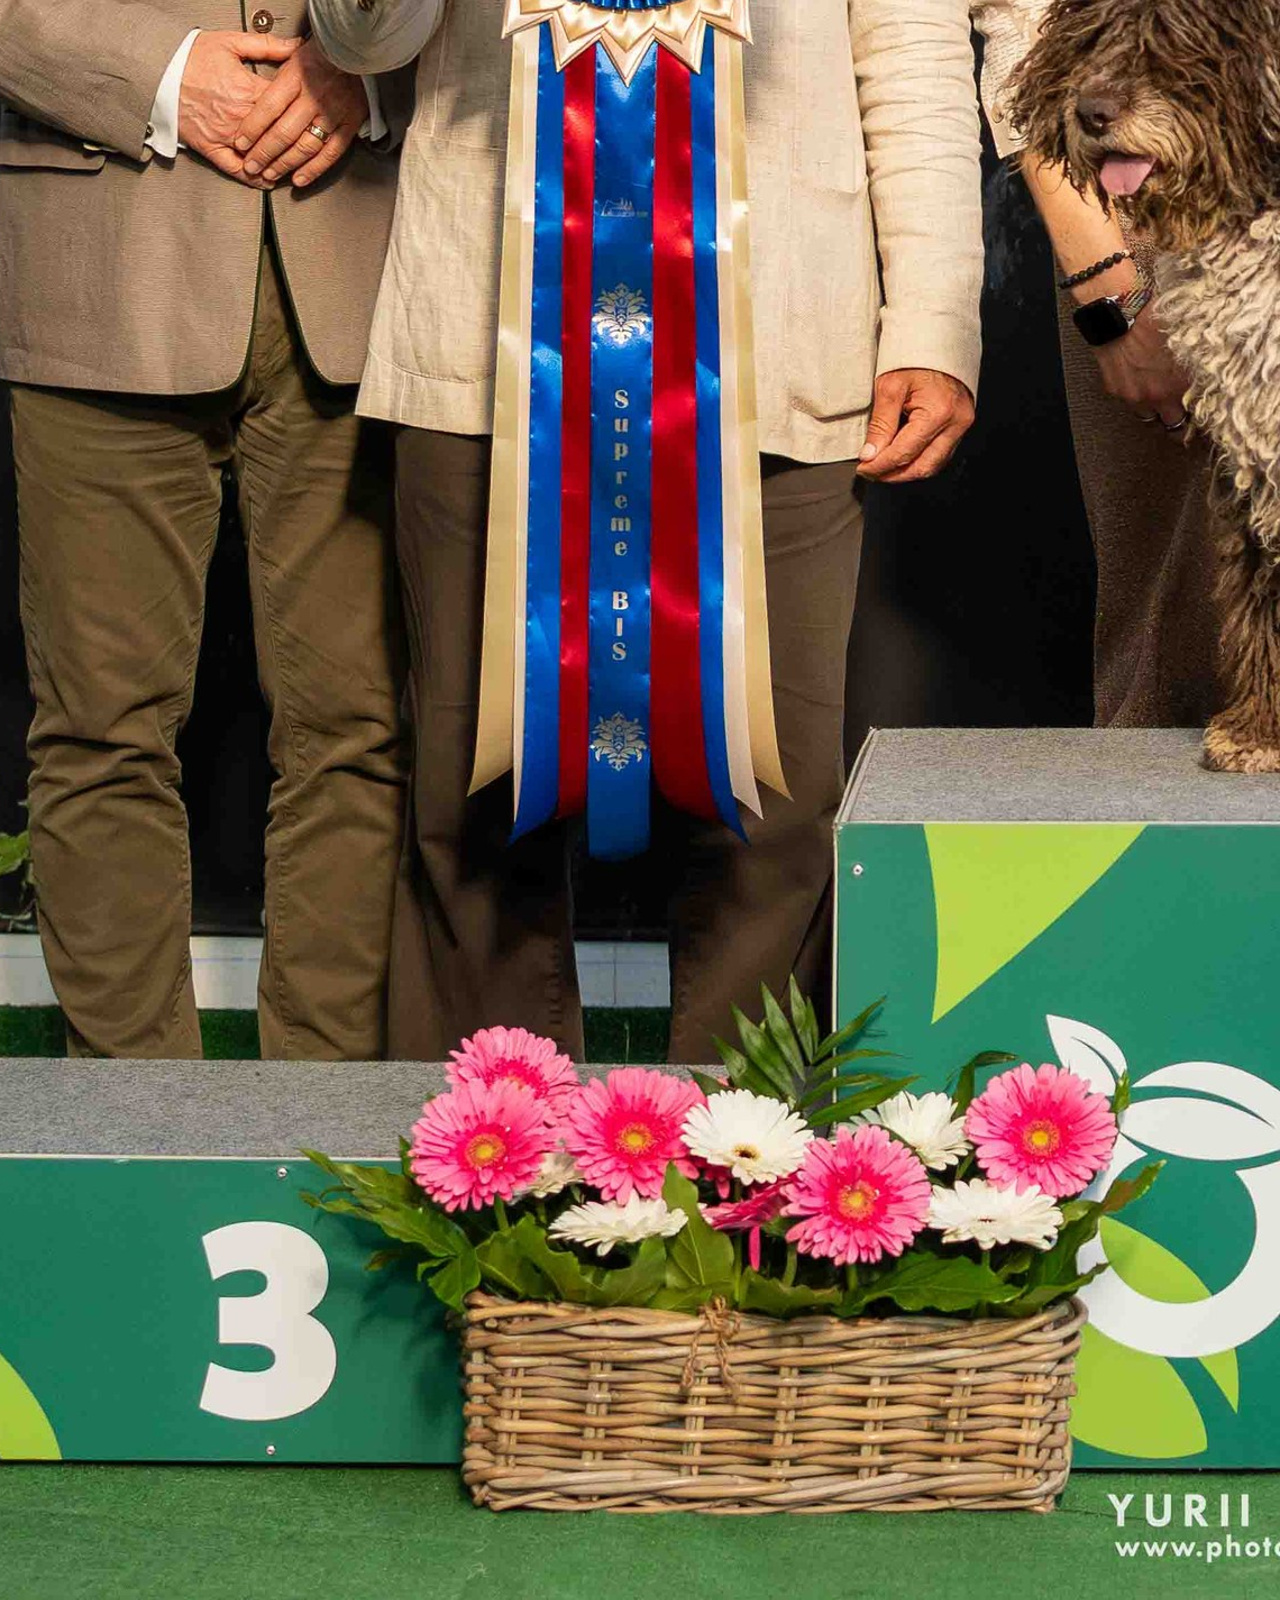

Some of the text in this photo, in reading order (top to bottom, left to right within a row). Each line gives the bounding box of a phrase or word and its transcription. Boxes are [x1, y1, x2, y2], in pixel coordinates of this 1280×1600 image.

[610, 389, 631, 661] Supreme BIS
[199, 1220, 338, 1422] 3
